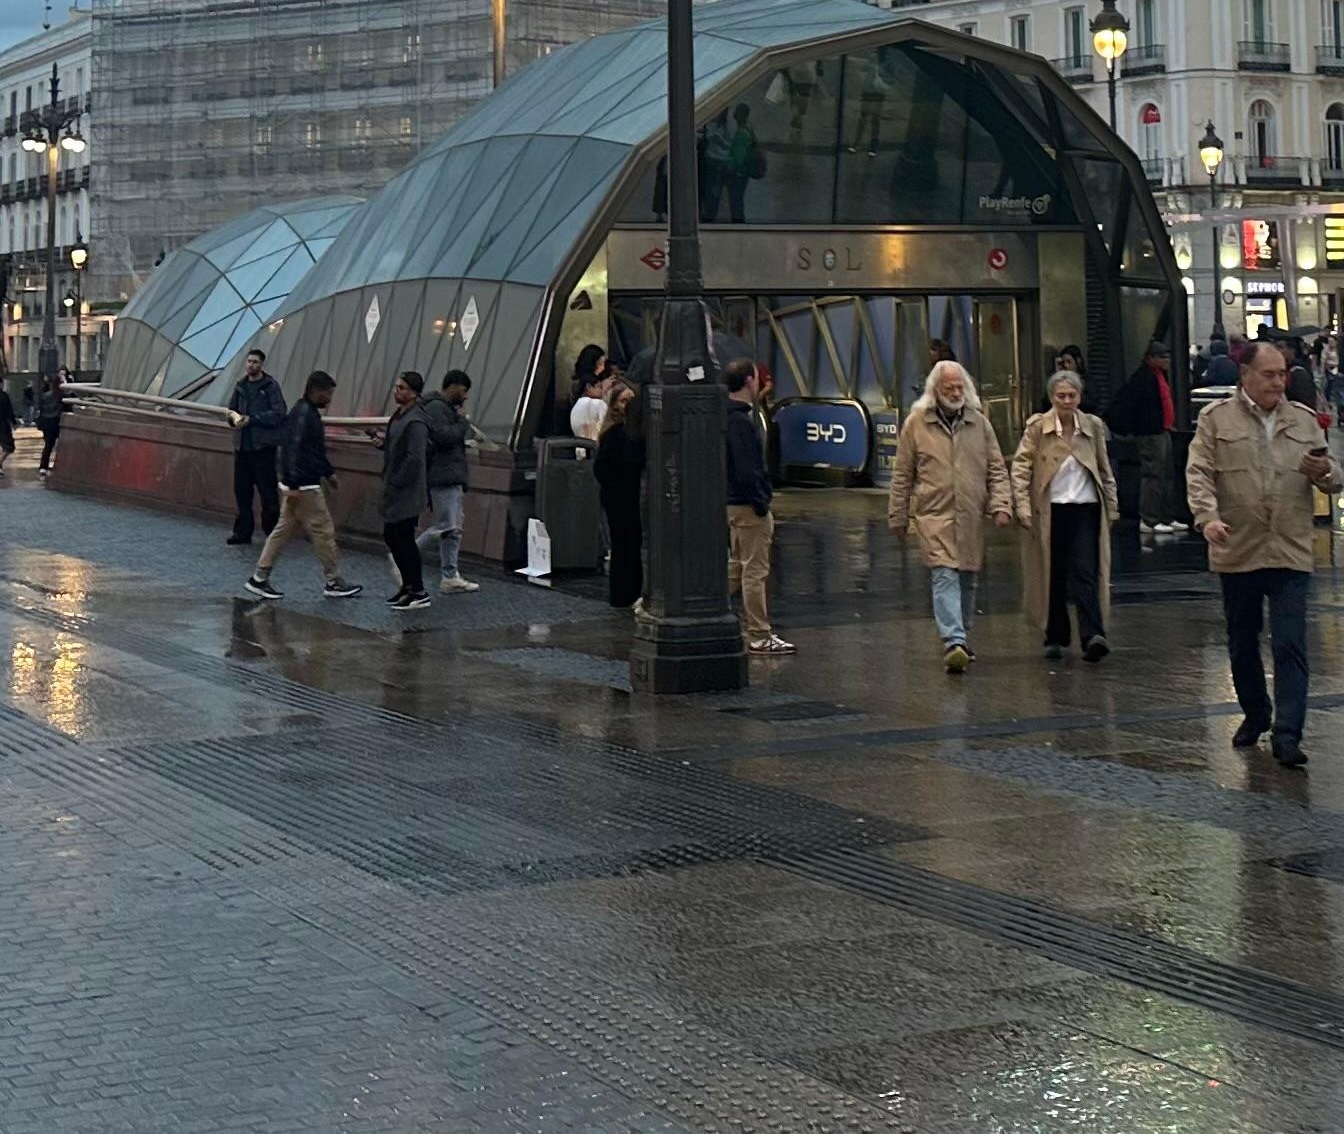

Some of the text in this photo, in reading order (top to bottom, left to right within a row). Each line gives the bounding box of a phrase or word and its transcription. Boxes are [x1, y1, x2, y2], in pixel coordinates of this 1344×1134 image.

[978, 196, 1032, 210] PlayRenfe
[797, 247, 862, 271] SOL
[806, 422, 847, 444] BYD
[876, 423, 897, 434] BYD
